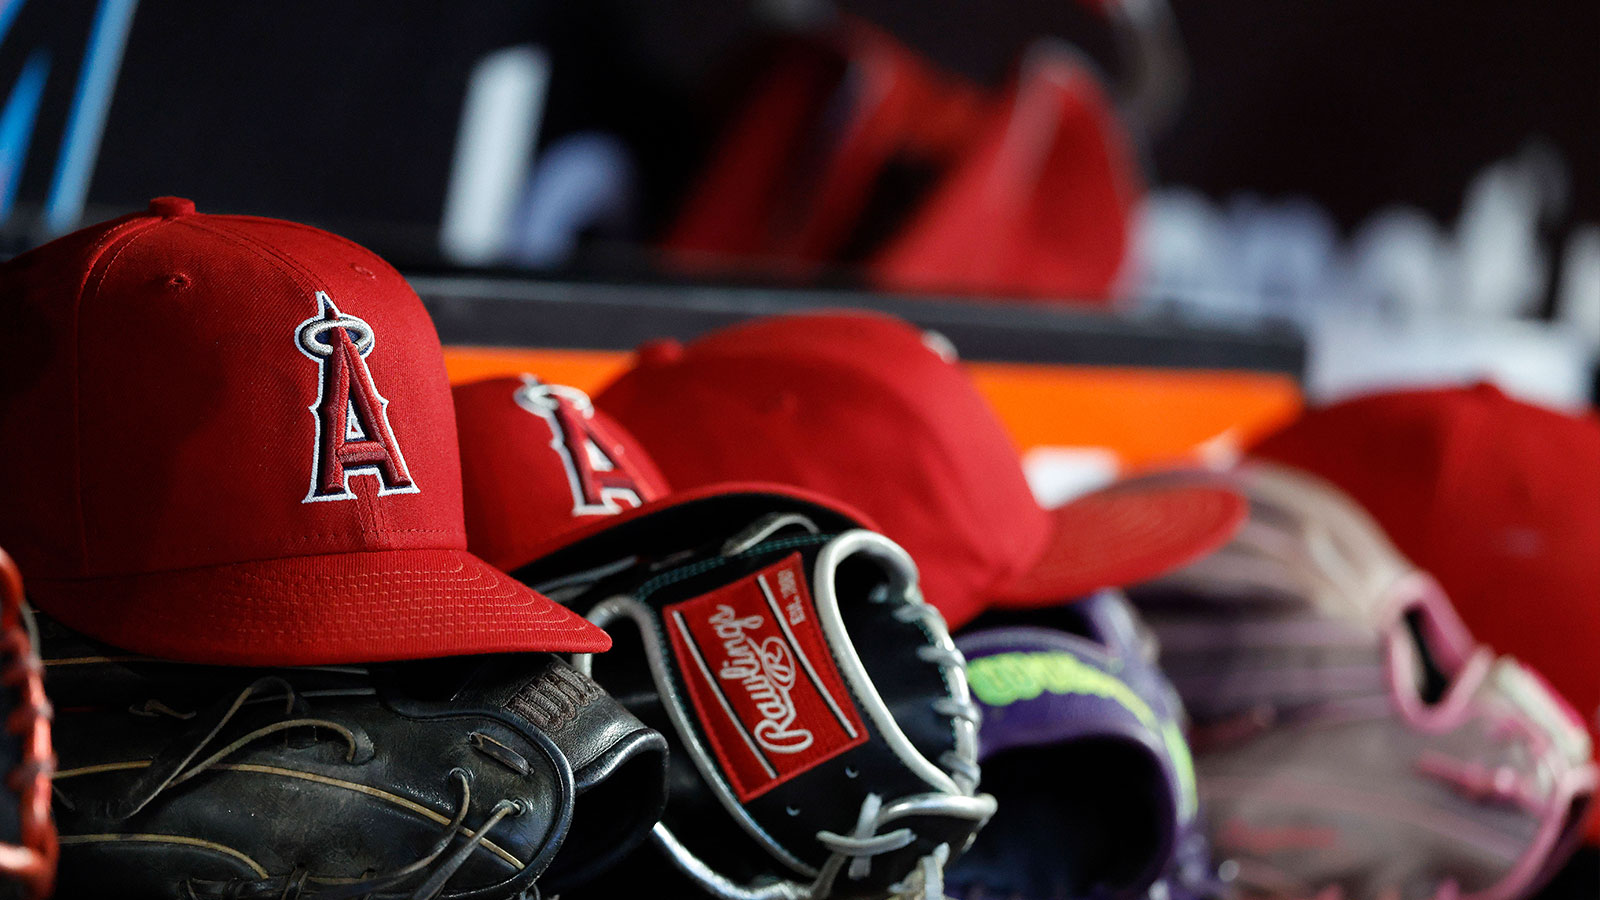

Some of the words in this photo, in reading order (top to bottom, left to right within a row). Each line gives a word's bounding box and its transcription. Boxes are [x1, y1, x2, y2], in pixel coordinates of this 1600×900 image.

[294, 291, 421, 504] A
[511, 373, 672, 516] A
[708, 604, 814, 754] Rawlings
